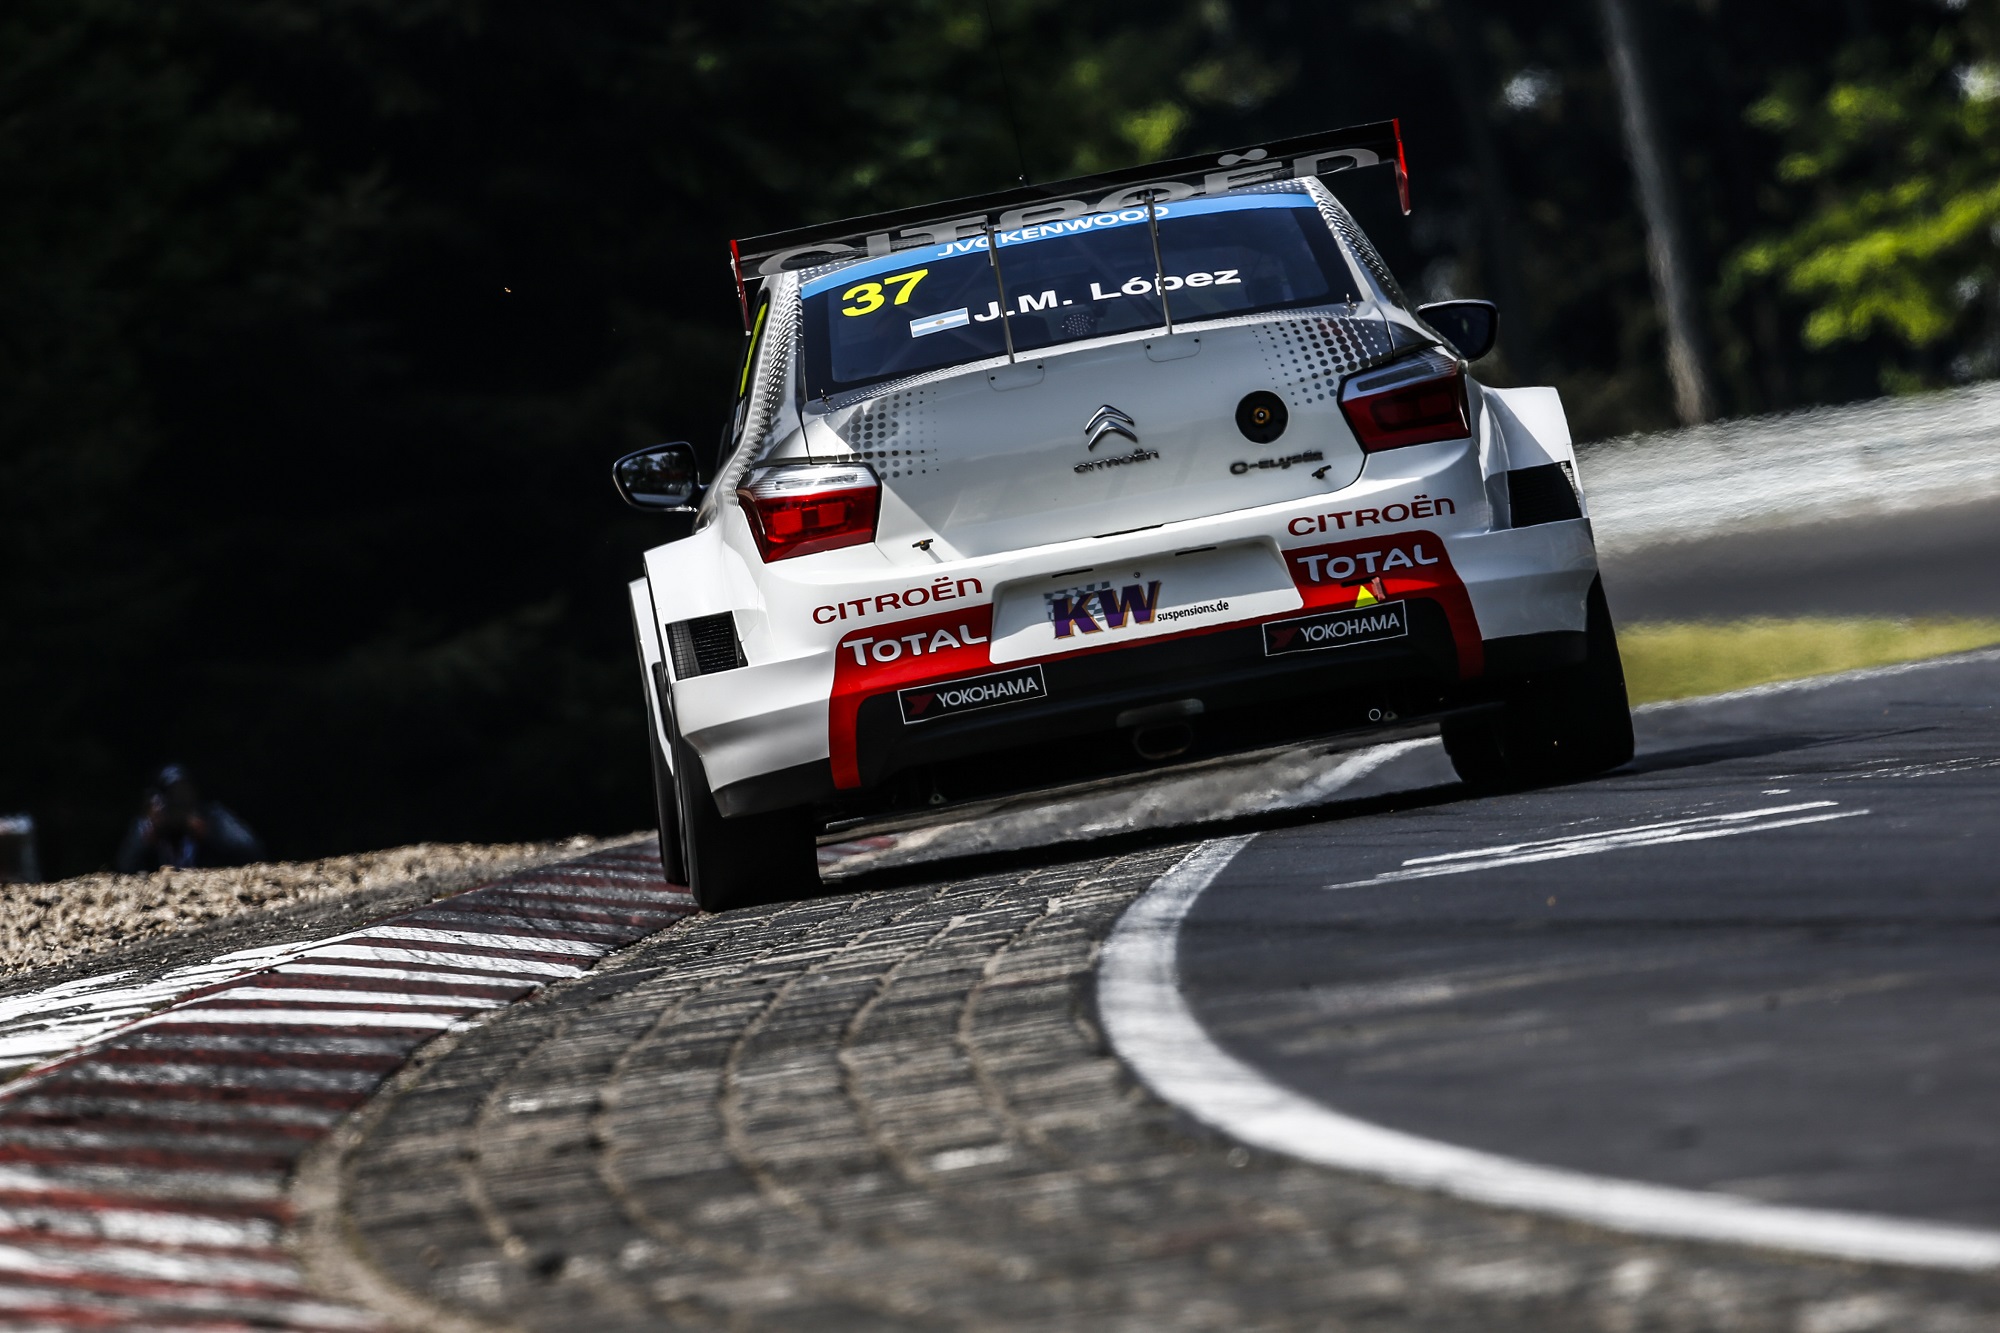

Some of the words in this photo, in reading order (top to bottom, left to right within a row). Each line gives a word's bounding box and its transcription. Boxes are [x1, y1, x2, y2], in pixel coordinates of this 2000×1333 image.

[842, 268, 928, 317] 37
[973, 289, 1073, 323] J.M.
[1090, 269, 1242, 301] López
[1297, 544, 1439, 582] TOTAL
[1053, 580, 1162, 639] KW
[1157, 600, 1229, 621] suspensions.de
[1300, 613, 1400, 642] YOKOHAMA
[842, 624, 988, 666] TOTAL
[936, 676, 1039, 708] YOKOHAMA
